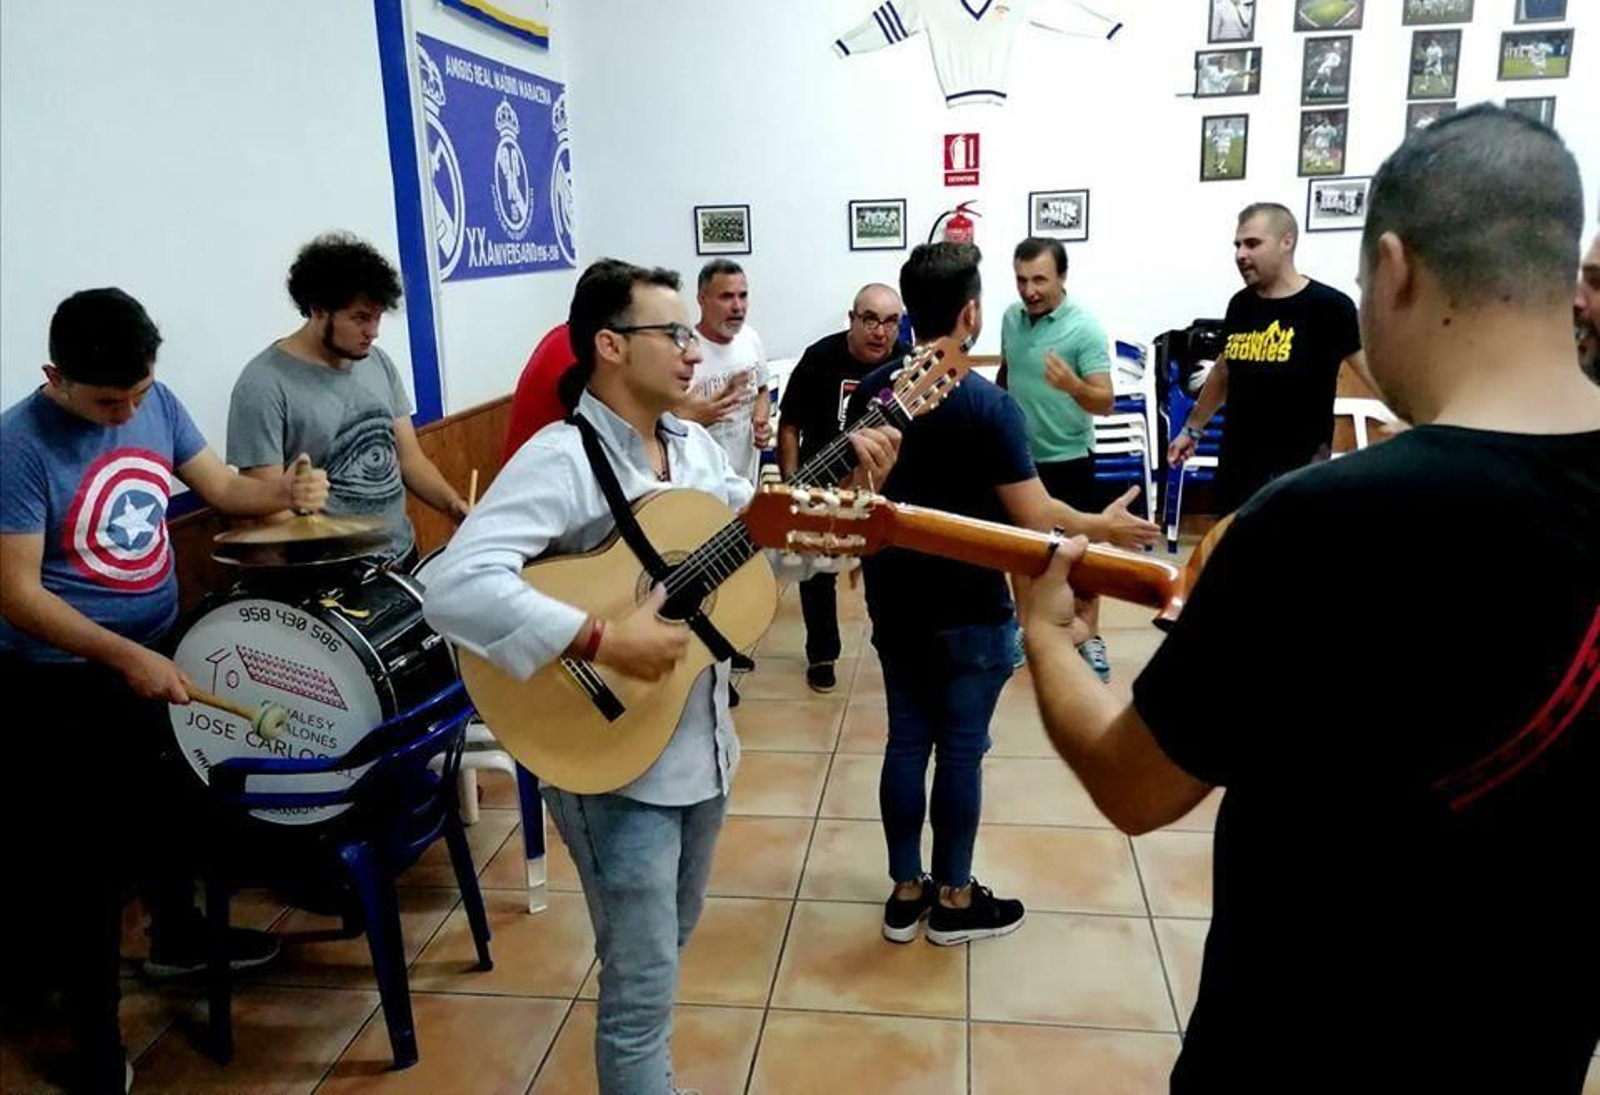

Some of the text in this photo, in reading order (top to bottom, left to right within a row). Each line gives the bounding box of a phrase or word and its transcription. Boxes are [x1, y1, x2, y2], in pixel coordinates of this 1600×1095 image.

[446, 55, 473, 83] AMIGOS
[473, 65, 493, 88] REAL
[239, 607, 343, 653] 958 430 586
[186, 711, 237, 741] JOSE
